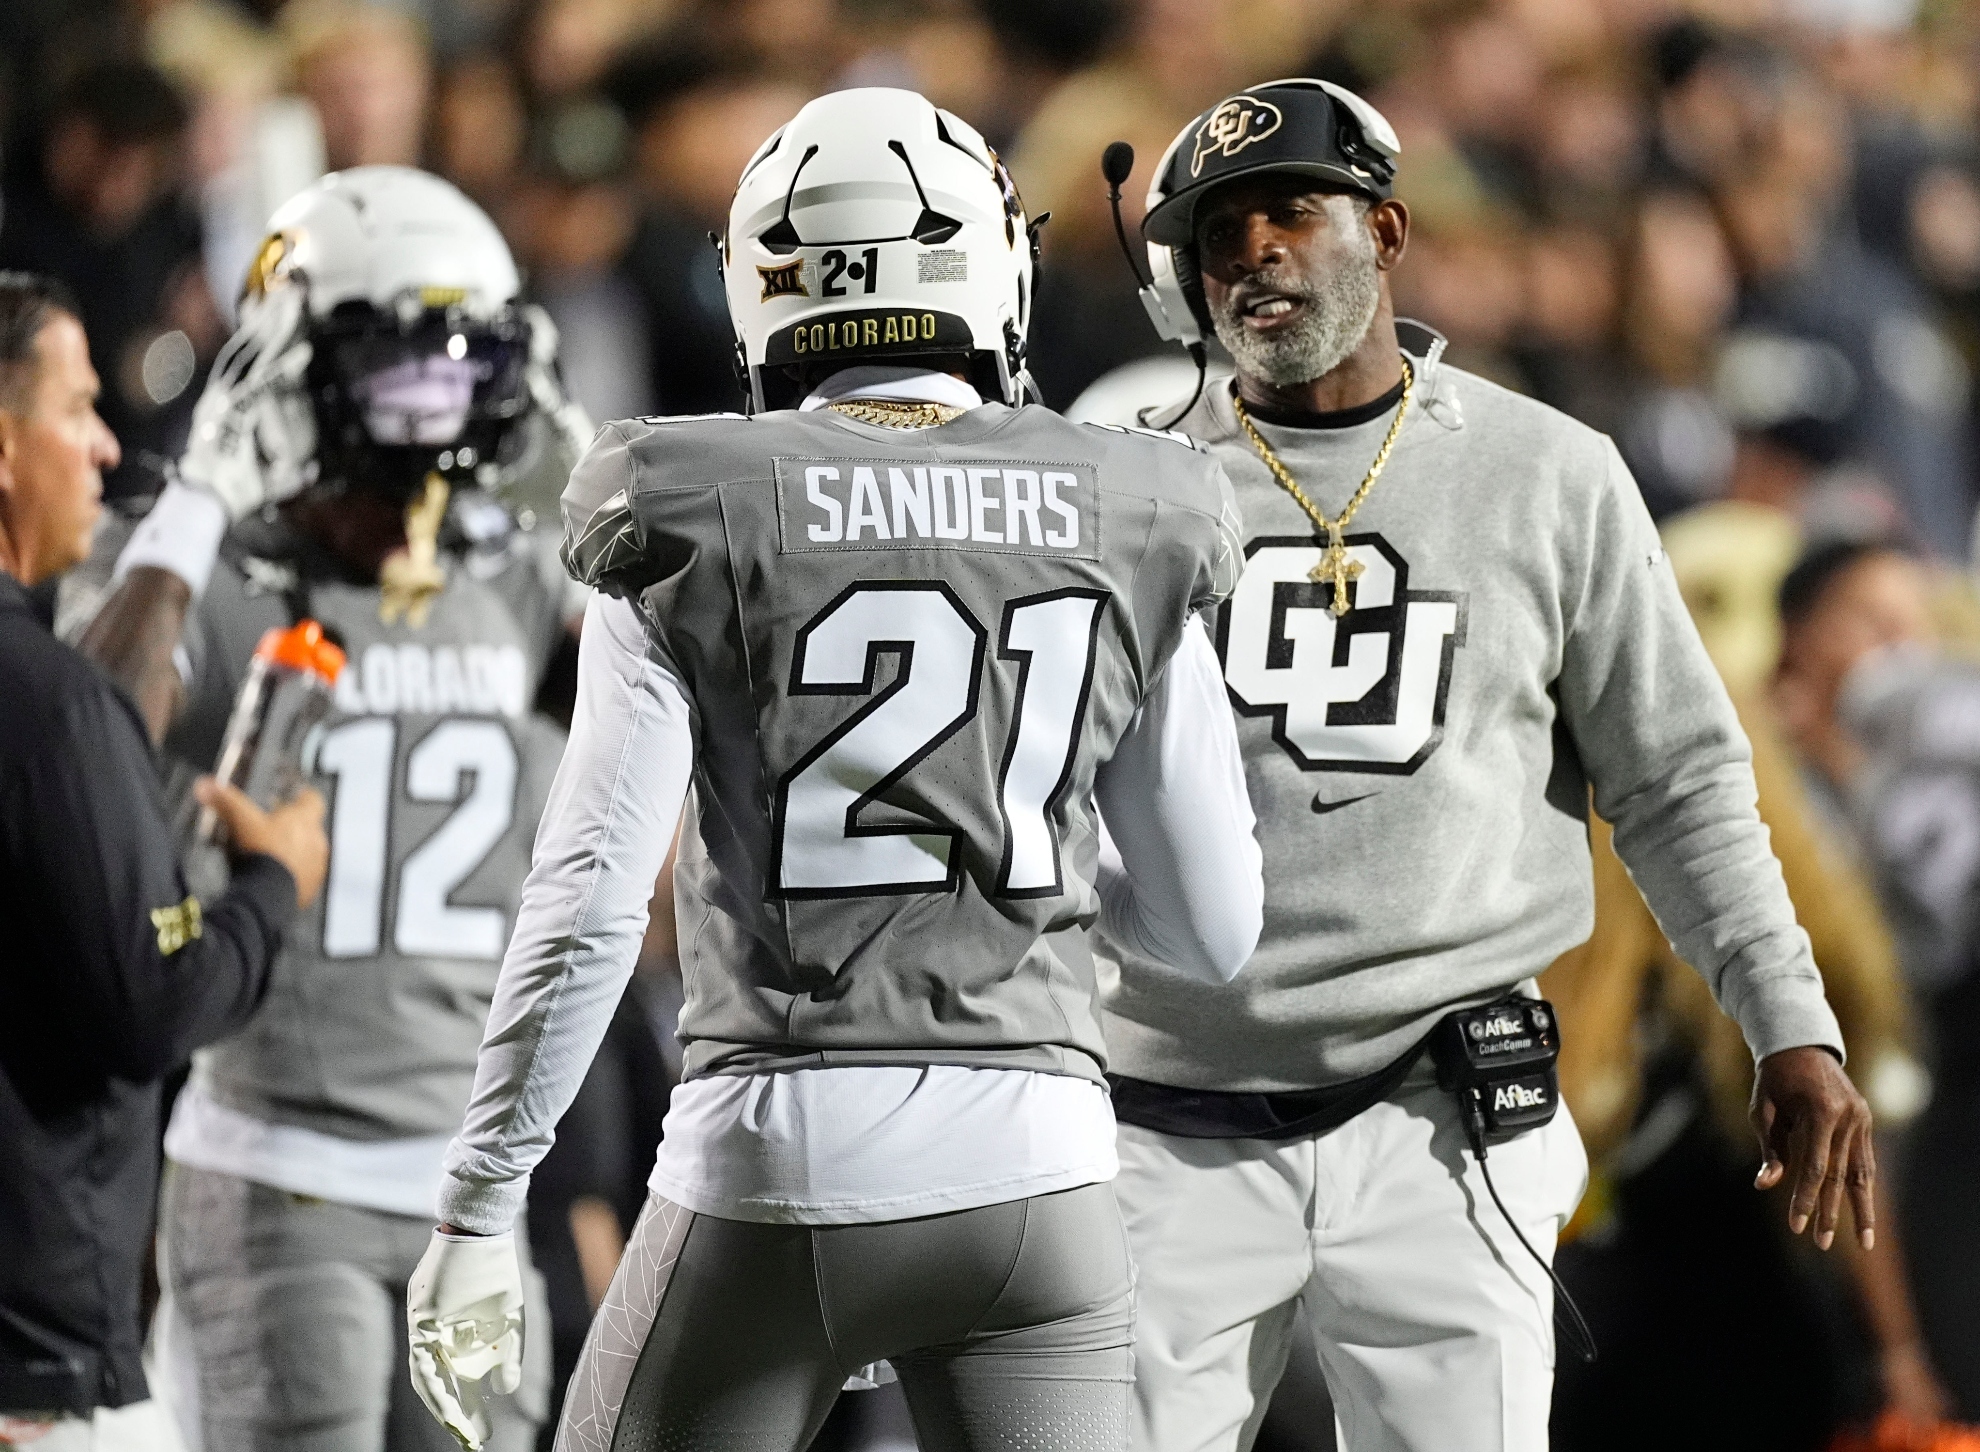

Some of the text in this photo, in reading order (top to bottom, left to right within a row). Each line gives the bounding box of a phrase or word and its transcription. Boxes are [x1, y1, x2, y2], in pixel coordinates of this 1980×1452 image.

[1208, 103, 1253, 143] CU
[794, 313, 936, 354] COLORADO
[804, 466, 1081, 549] SANDERS
[1216, 532, 1470, 776] CU
[768, 579, 1112, 898] 21
[318, 715, 518, 958] 12
[1479, 1038, 1532, 1055] CoachComm
[1485, 1016, 1523, 1037] Aflac
[1494, 1084, 1547, 1111] Aflac
